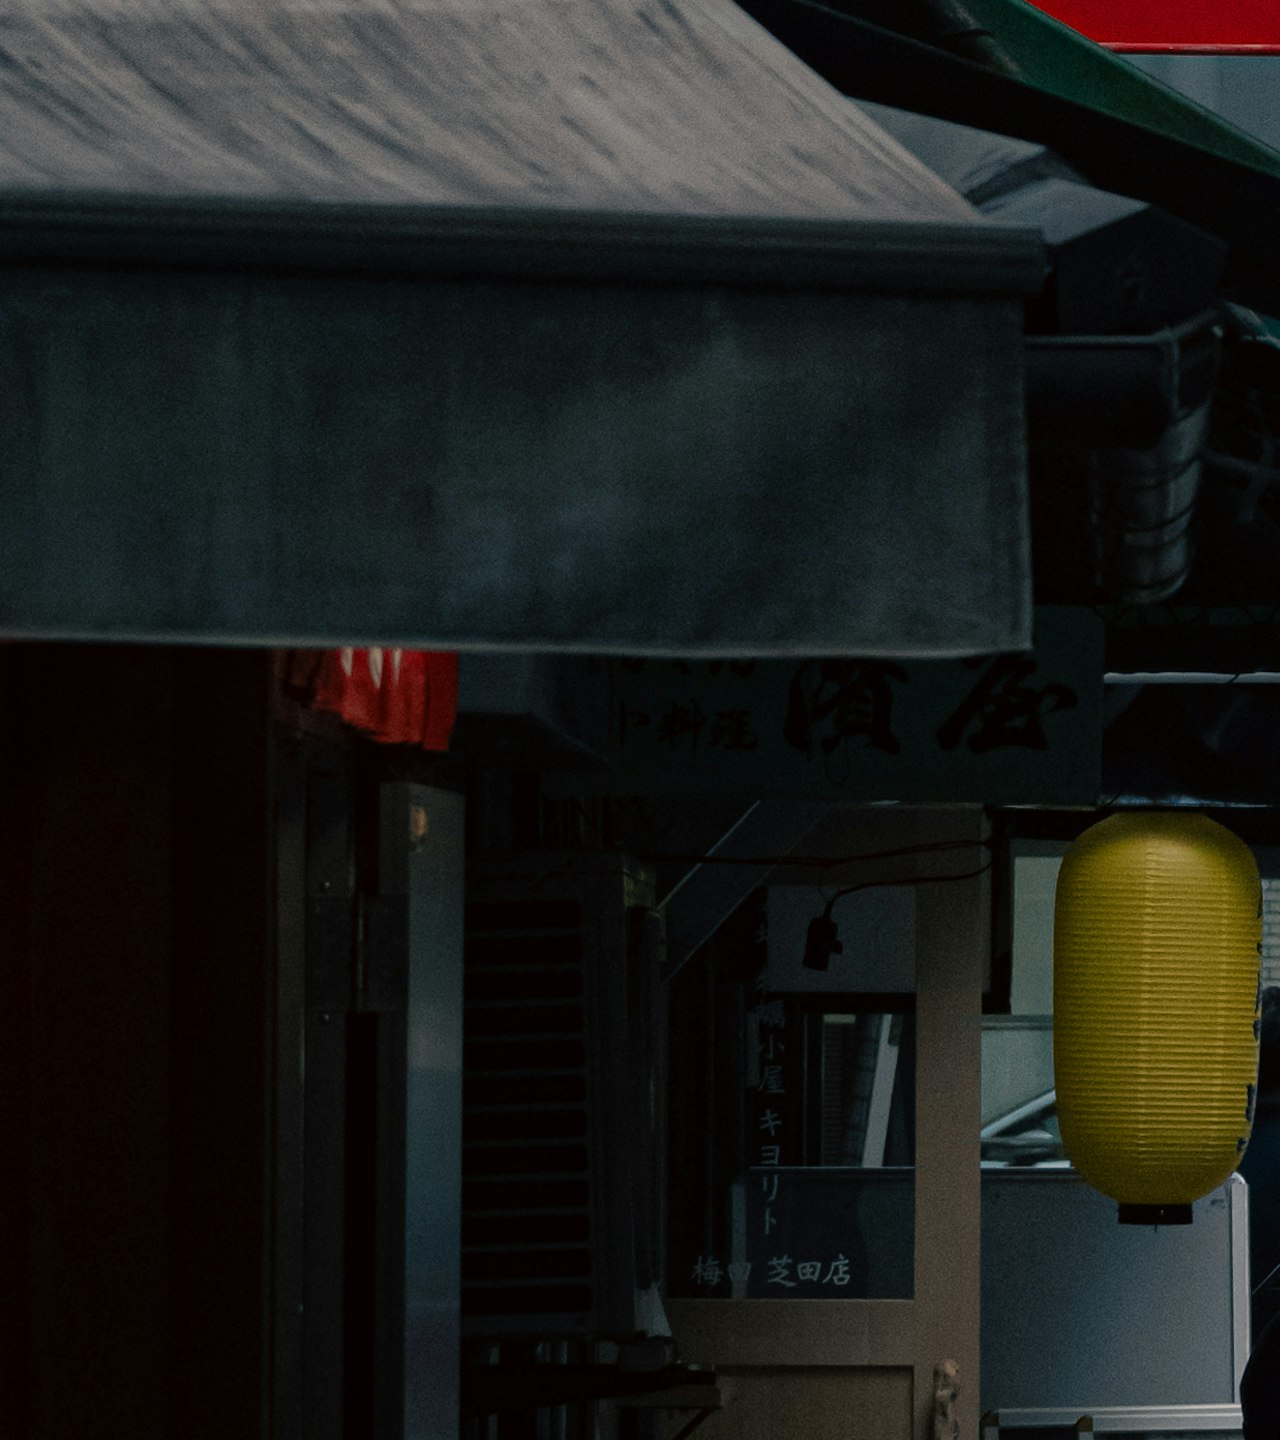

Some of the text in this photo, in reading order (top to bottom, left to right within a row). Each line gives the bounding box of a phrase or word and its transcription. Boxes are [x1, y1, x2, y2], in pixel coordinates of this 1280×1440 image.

[690, 1251, 854, 1290] 梅田 芝田店
